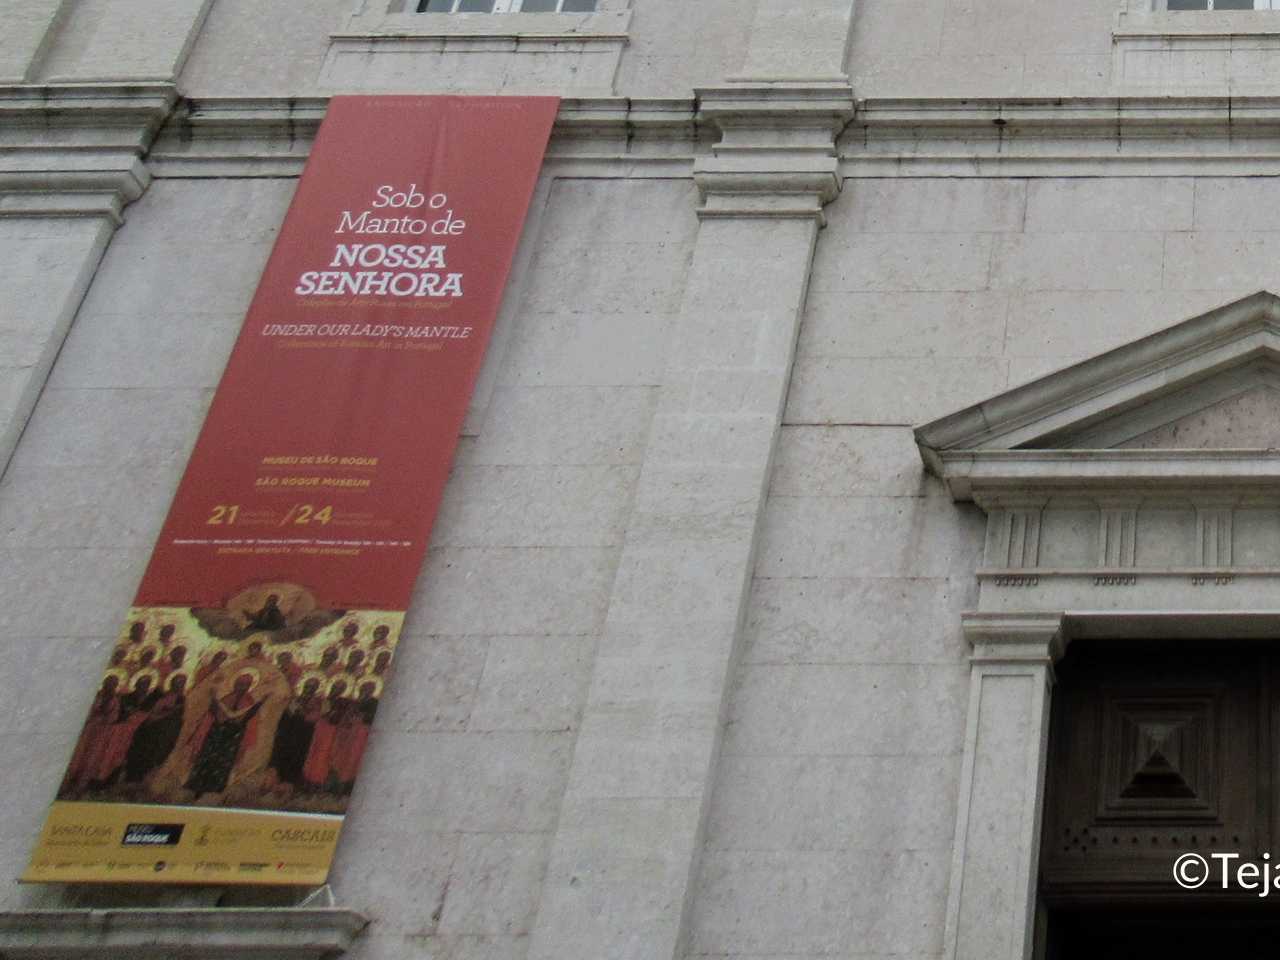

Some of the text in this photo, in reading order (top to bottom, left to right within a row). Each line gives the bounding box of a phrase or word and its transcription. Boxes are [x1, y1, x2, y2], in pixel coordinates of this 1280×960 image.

[372, 184, 447, 208] Sob o
[335, 210, 466, 235] Manto de
[330, 244, 446, 269] NOSSA
[295, 271, 463, 297] SENHORA
[262, 324, 473, 339] UNDER OUR LADY'S MANTLE
[340, 457, 378, 466] ROQUE
[322, 477, 371, 487] MUSEUM
[206, 505, 240, 525] 21
